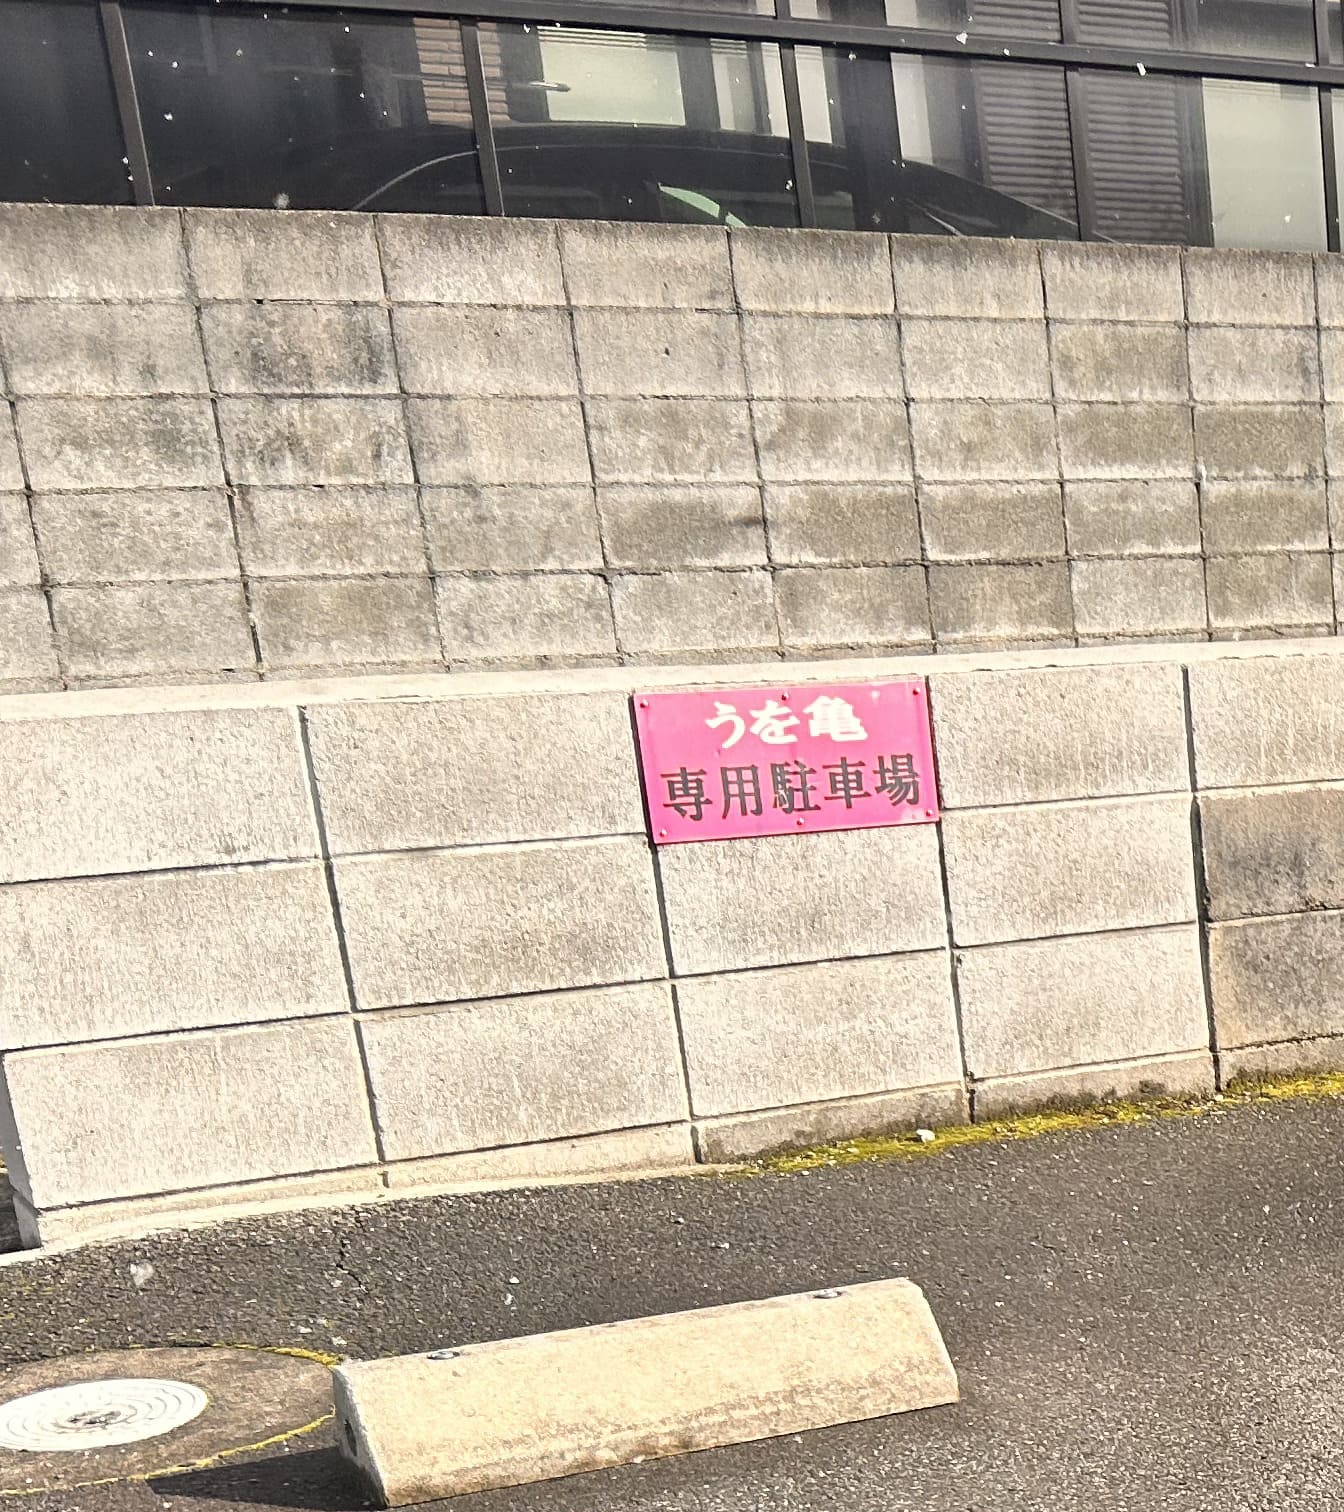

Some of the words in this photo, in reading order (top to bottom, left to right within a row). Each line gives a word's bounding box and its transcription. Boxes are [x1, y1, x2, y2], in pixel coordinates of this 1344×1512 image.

[706, 696, 868, 748] うを亀
[660, 753, 921, 821] 専用駐車場
